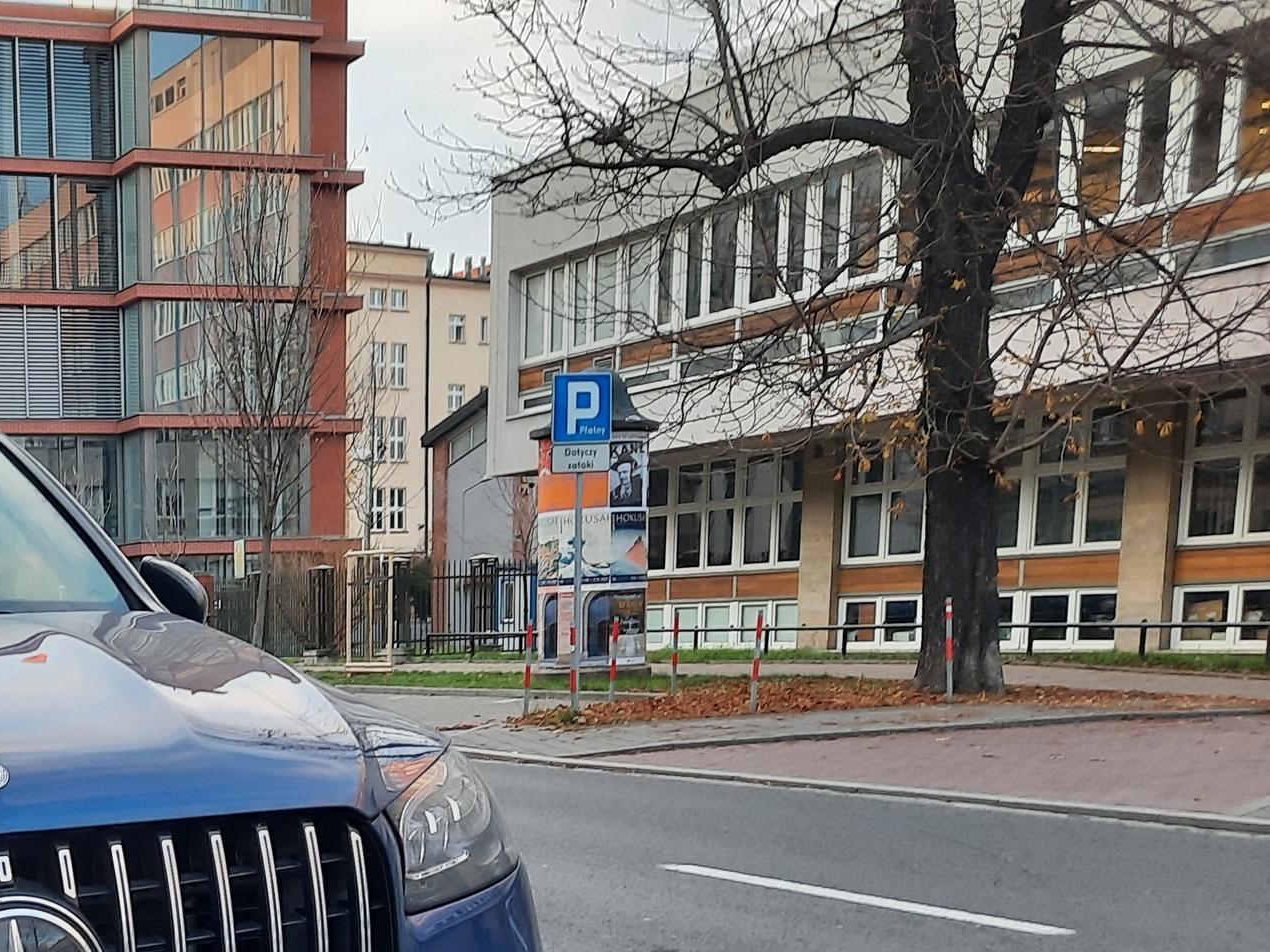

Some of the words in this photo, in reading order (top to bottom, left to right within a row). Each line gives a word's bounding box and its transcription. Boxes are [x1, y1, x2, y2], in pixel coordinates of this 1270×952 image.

[567, 381, 600, 435] P
[564, 447, 598, 458] Dotyczy
[567, 460, 594, 470] zatoki
[564, 514, 609, 525] HOUSAI
